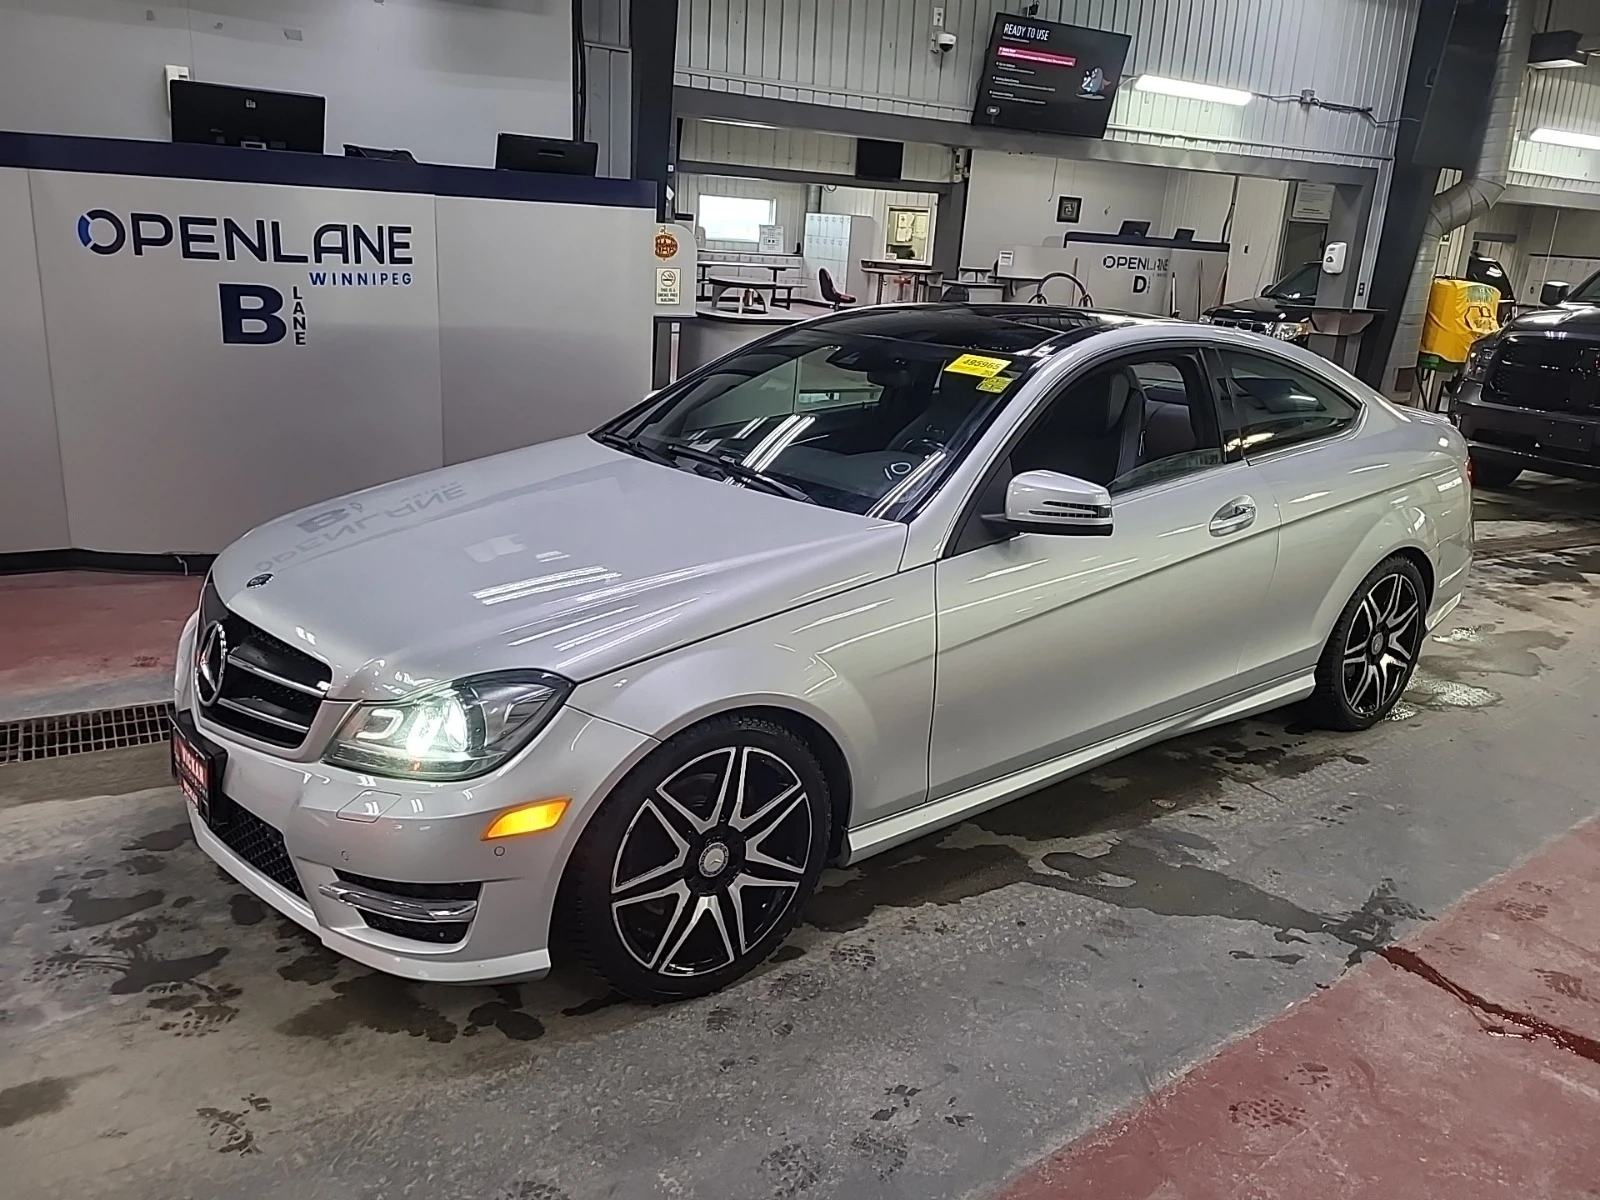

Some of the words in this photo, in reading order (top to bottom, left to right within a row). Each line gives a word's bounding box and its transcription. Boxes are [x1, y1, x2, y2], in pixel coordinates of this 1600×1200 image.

[1003, 23, 1026, 36] READY
[1027, 27, 1035, 38] TO
[1036, 29, 1049, 41] USE
[78, 208, 413, 266] OPENLANE
[309, 271, 412, 286] WINNIPEG
[1132, 275, 1148, 294] D
[218, 283, 288, 345] B
[292, 286, 307, 345] LANE
